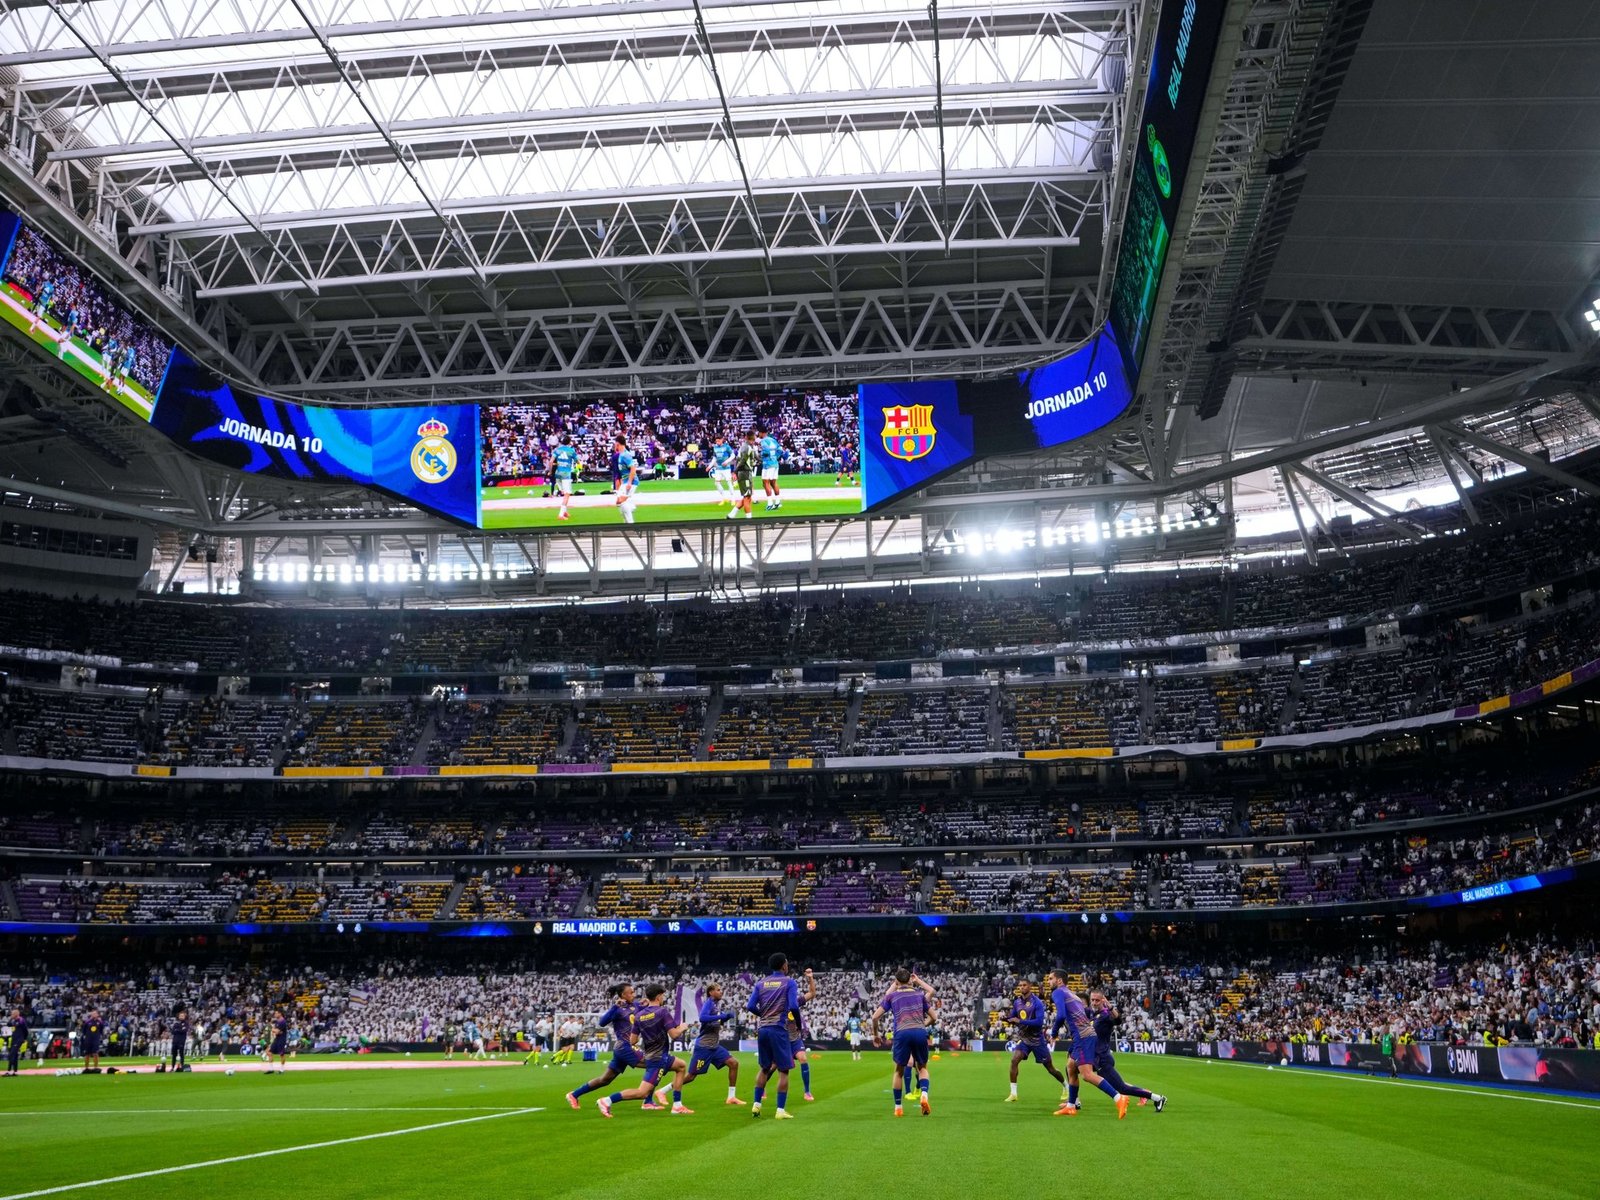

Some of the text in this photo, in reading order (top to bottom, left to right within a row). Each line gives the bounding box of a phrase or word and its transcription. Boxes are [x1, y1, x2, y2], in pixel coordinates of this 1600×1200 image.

[1168, 60, 1182, 110] REAL
[1024, 371, 1107, 420] JORNADA 10
[219, 417, 323, 454] JORNADA 10
[1462, 891, 1474, 902] REAL
[1475, 887, 1494, 899] MADRID
[552, 922, 638, 933] REAL MADRID C. F.
[668, 921, 680, 931] VS
[716, 920, 794, 931] F. C. BARCELONA
[577, 1041, 610, 1052] BMW
[1134, 1041, 1166, 1054] BMW
[1307, 1045, 1320, 1062] BMW
[1456, 1049, 1479, 1074] BMW
